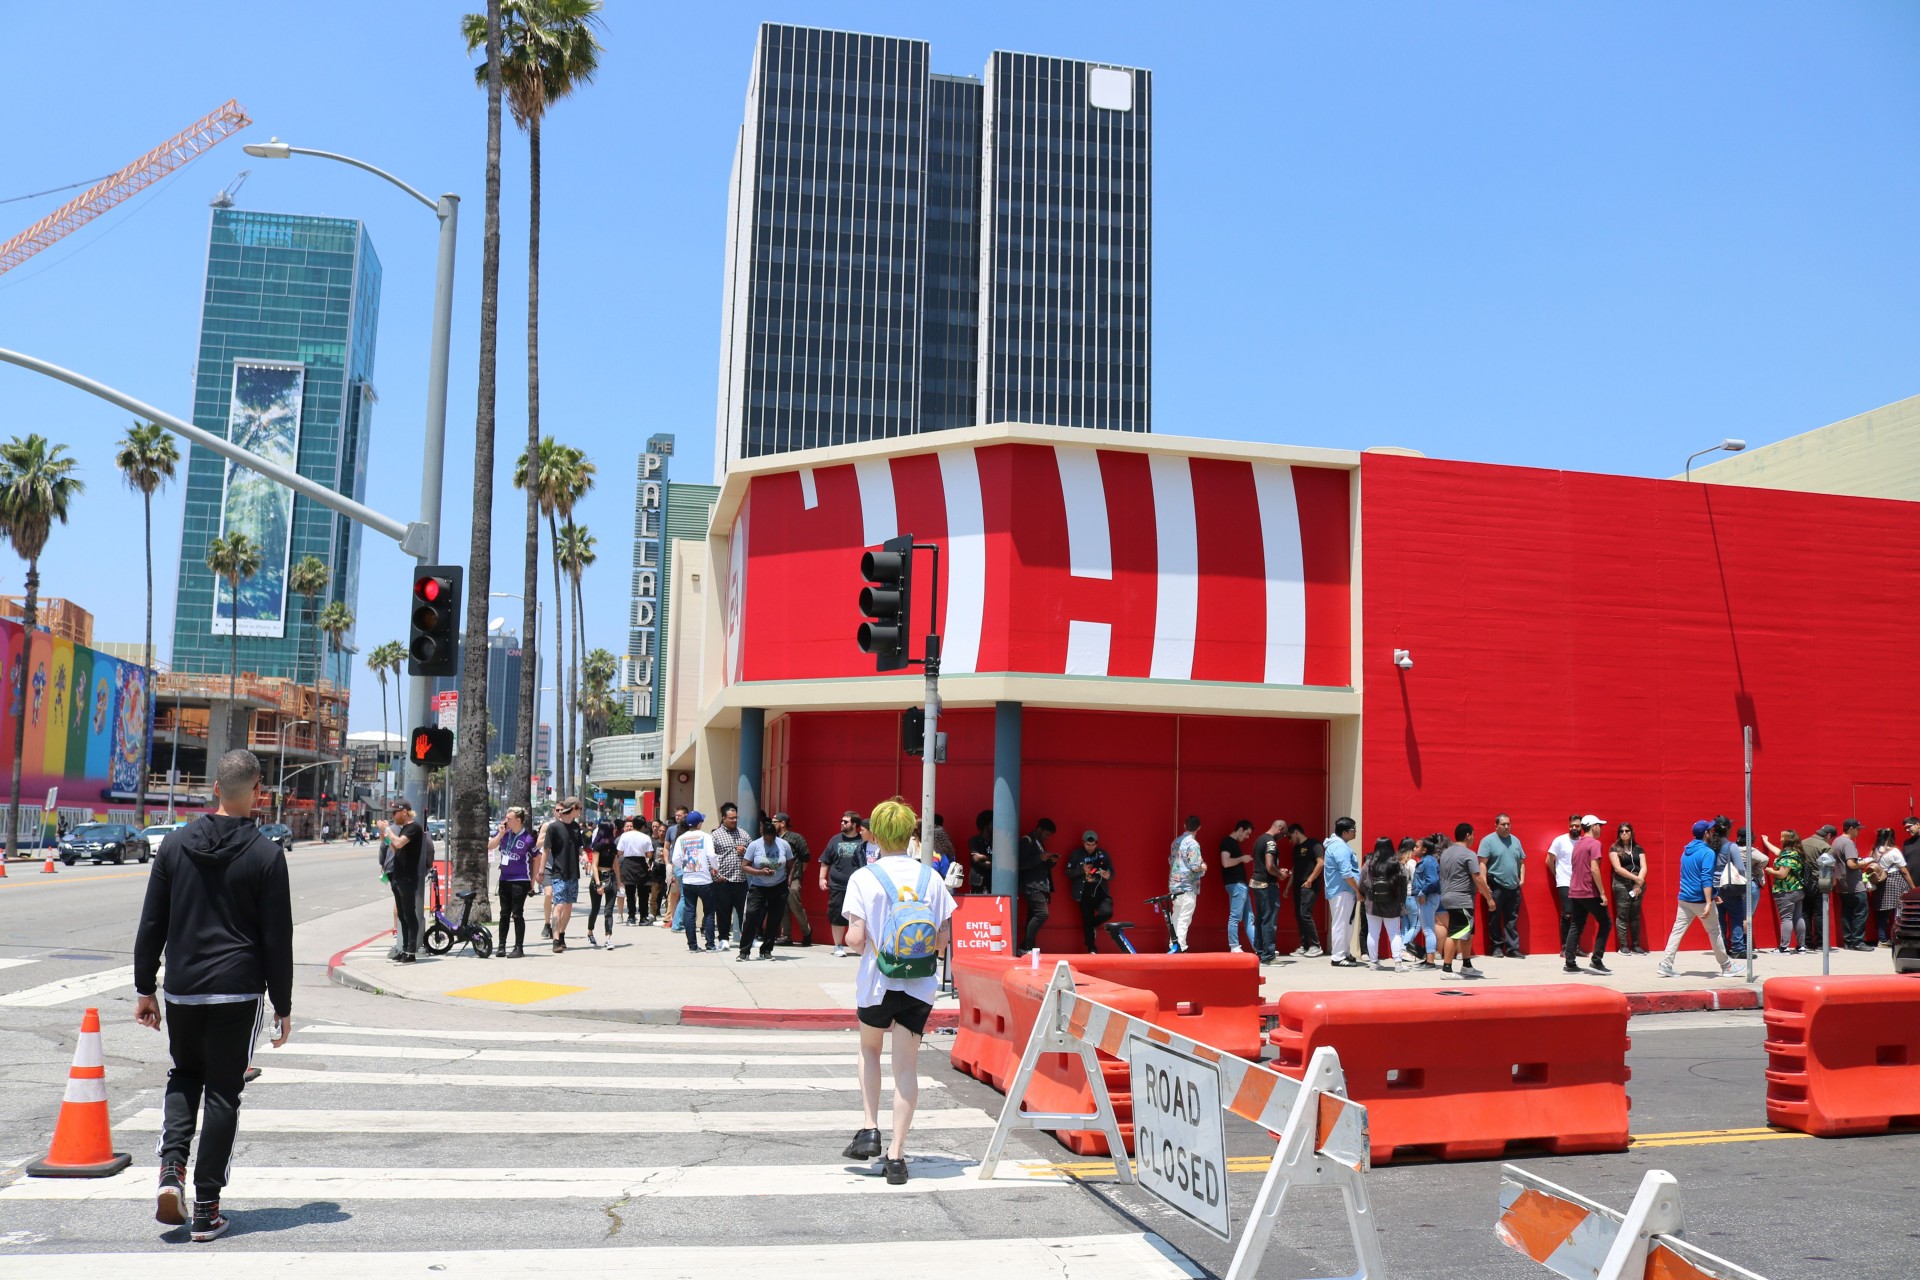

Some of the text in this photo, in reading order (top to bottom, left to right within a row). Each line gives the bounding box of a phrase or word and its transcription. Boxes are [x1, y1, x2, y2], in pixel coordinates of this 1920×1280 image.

[648, 440, 672, 454] THE
[633, 453, 661, 717] PALLADIUM
[957, 940, 1007, 948] EL CENO
[966, 922, 991, 930] ENTE
[1145, 1063, 1201, 1127] ROAD
[1139, 1125, 1220, 1209] CLOSED
